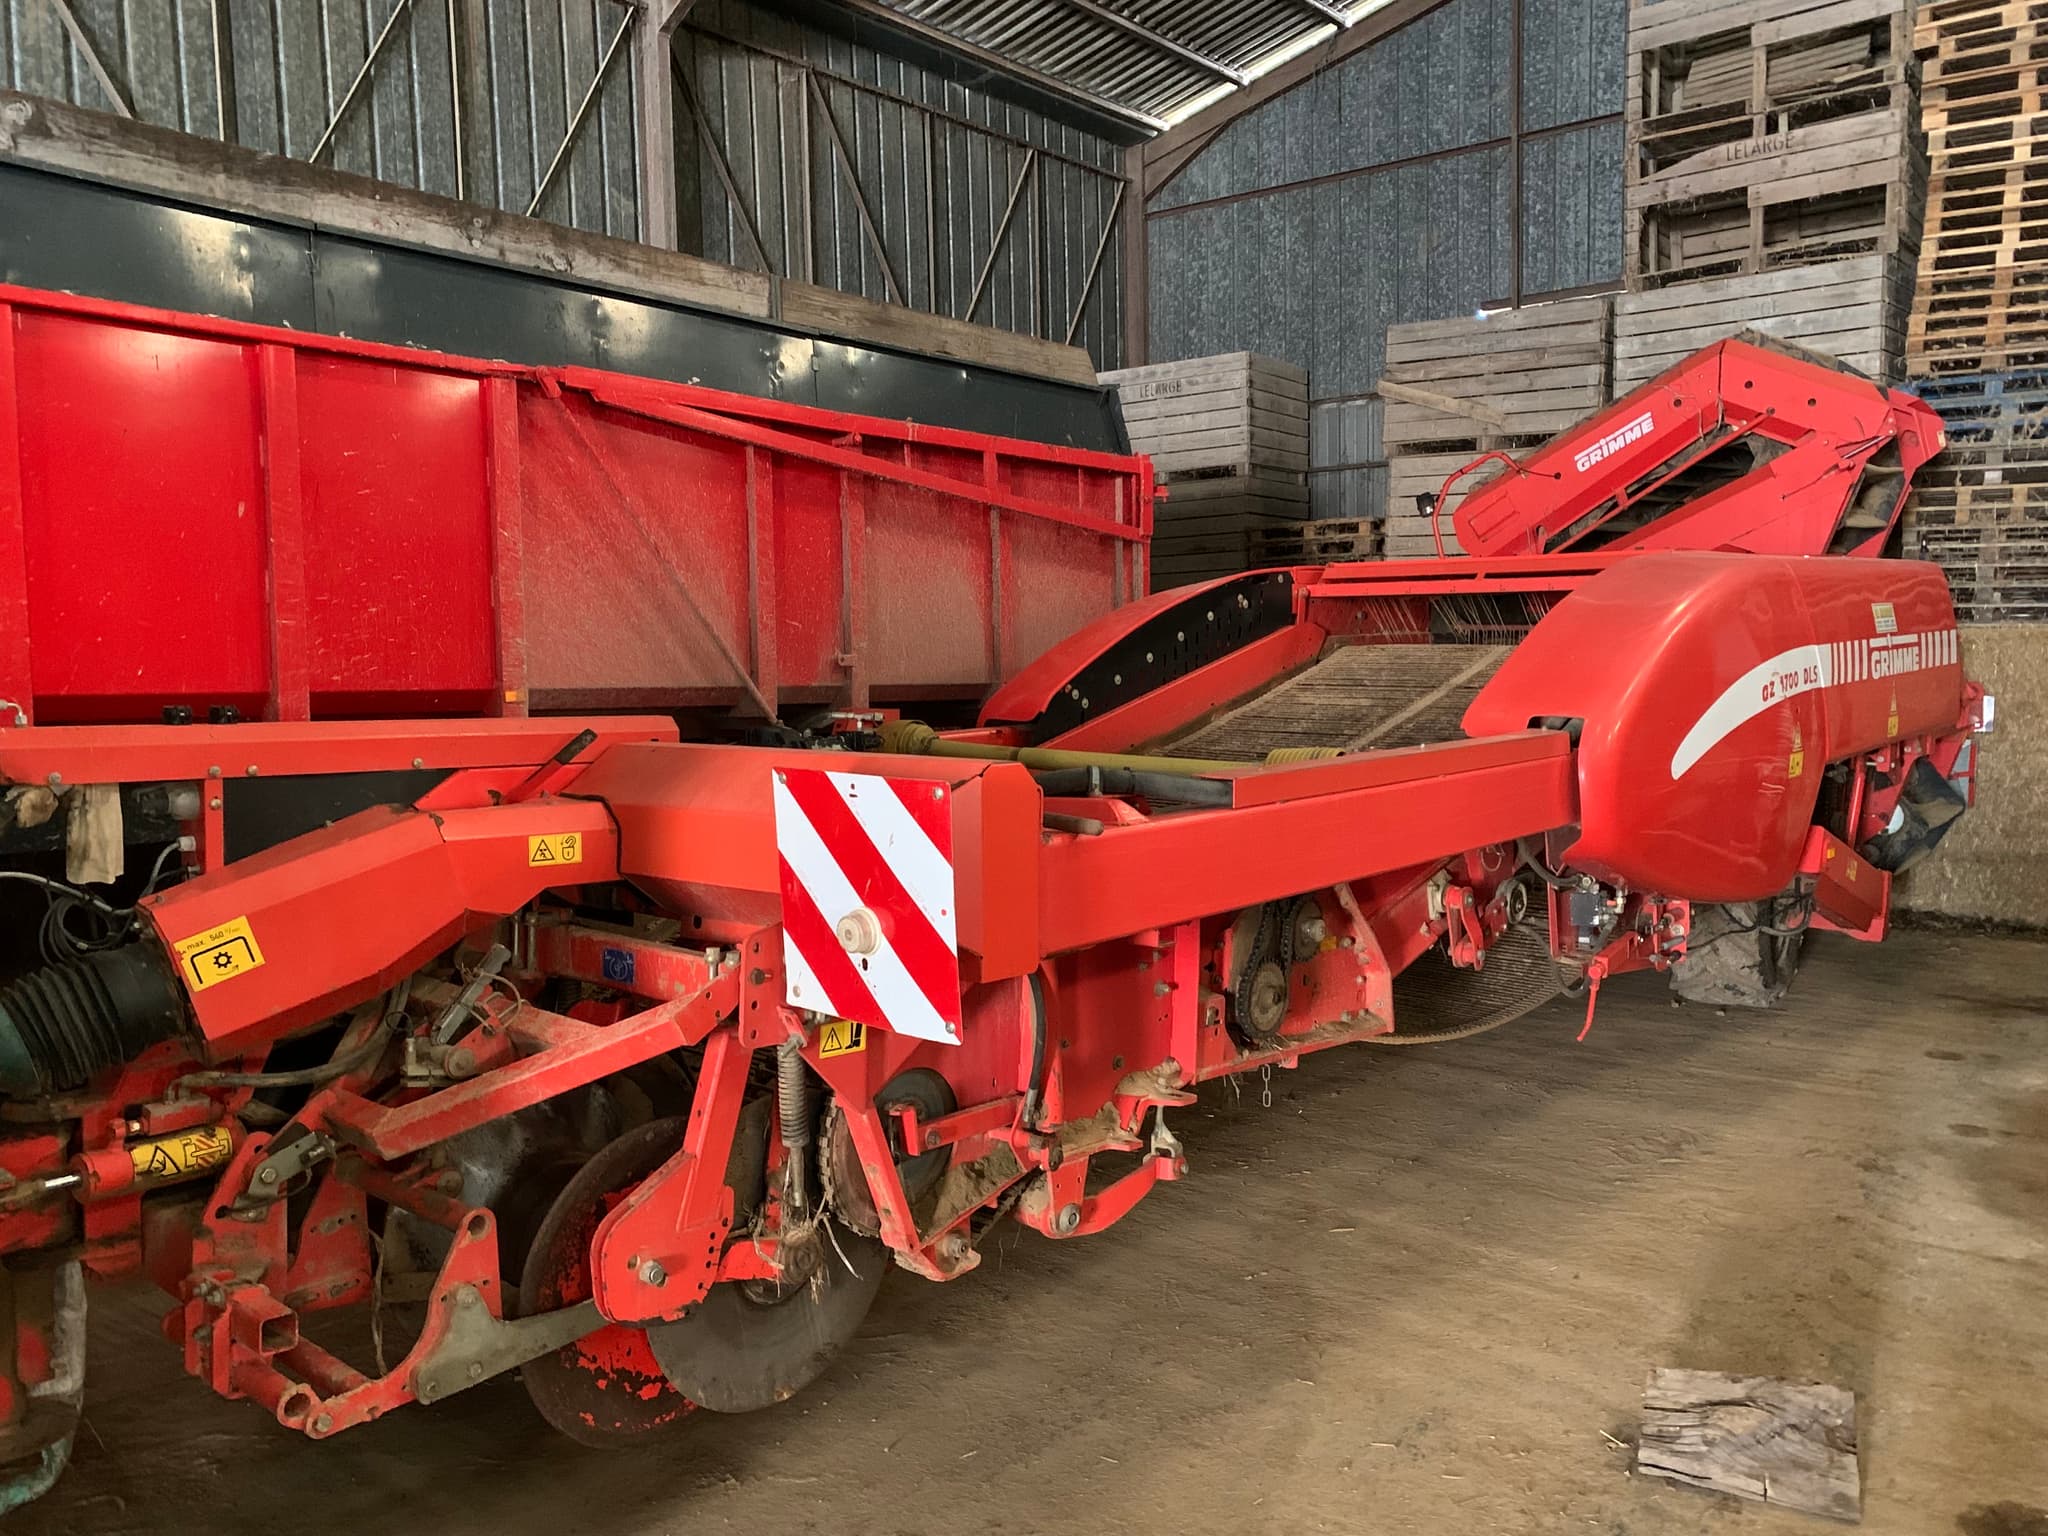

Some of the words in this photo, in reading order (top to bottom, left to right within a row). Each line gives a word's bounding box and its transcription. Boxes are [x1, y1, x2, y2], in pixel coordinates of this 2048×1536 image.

[1727, 132, 1794, 161] LELARGE
[1140, 380, 1182, 398] LELARGE
[1575, 413, 1655, 472] GRIMME
[1871, 645, 1920, 680] GRIMME
[1780, 670, 1799, 693] 1700
[1803, 664, 1818, 685] DLS
